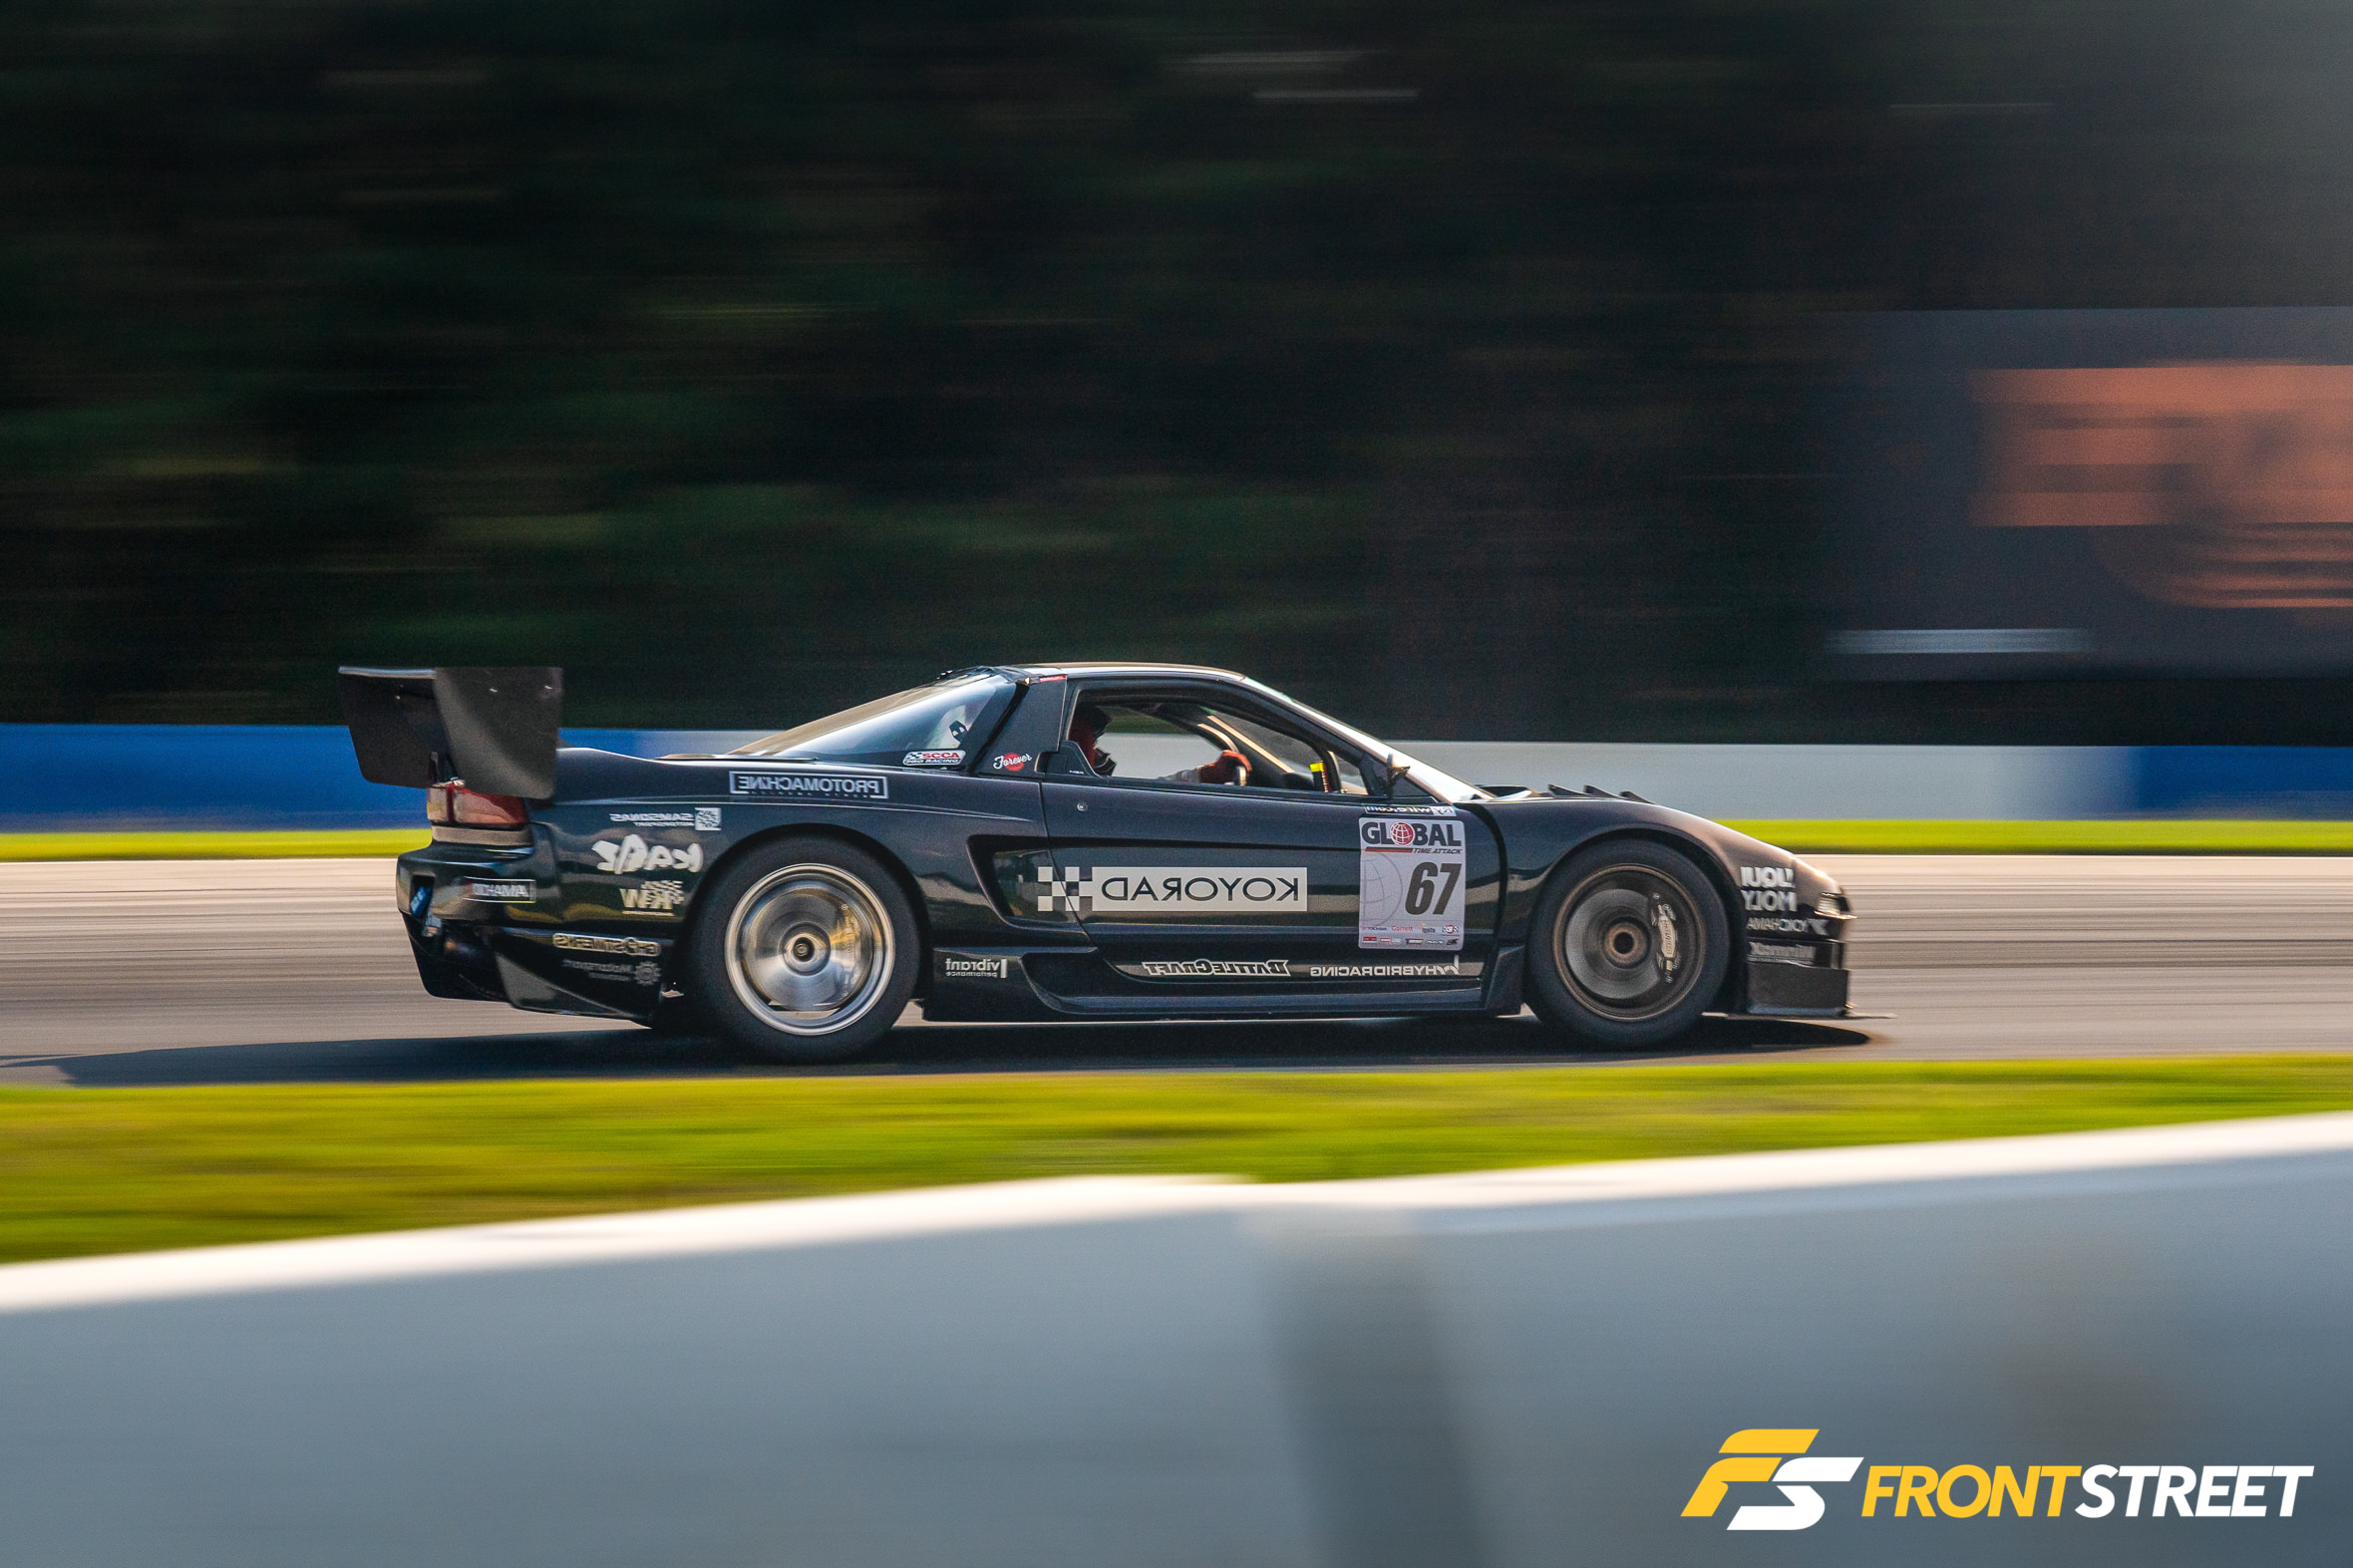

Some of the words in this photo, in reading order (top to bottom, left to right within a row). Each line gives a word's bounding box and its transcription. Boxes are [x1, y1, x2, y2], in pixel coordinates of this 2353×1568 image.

[993, 753, 1032, 771] Forever
[1361, 820, 1462, 847] GLOBAL
[1405, 861, 1462, 915] 67
